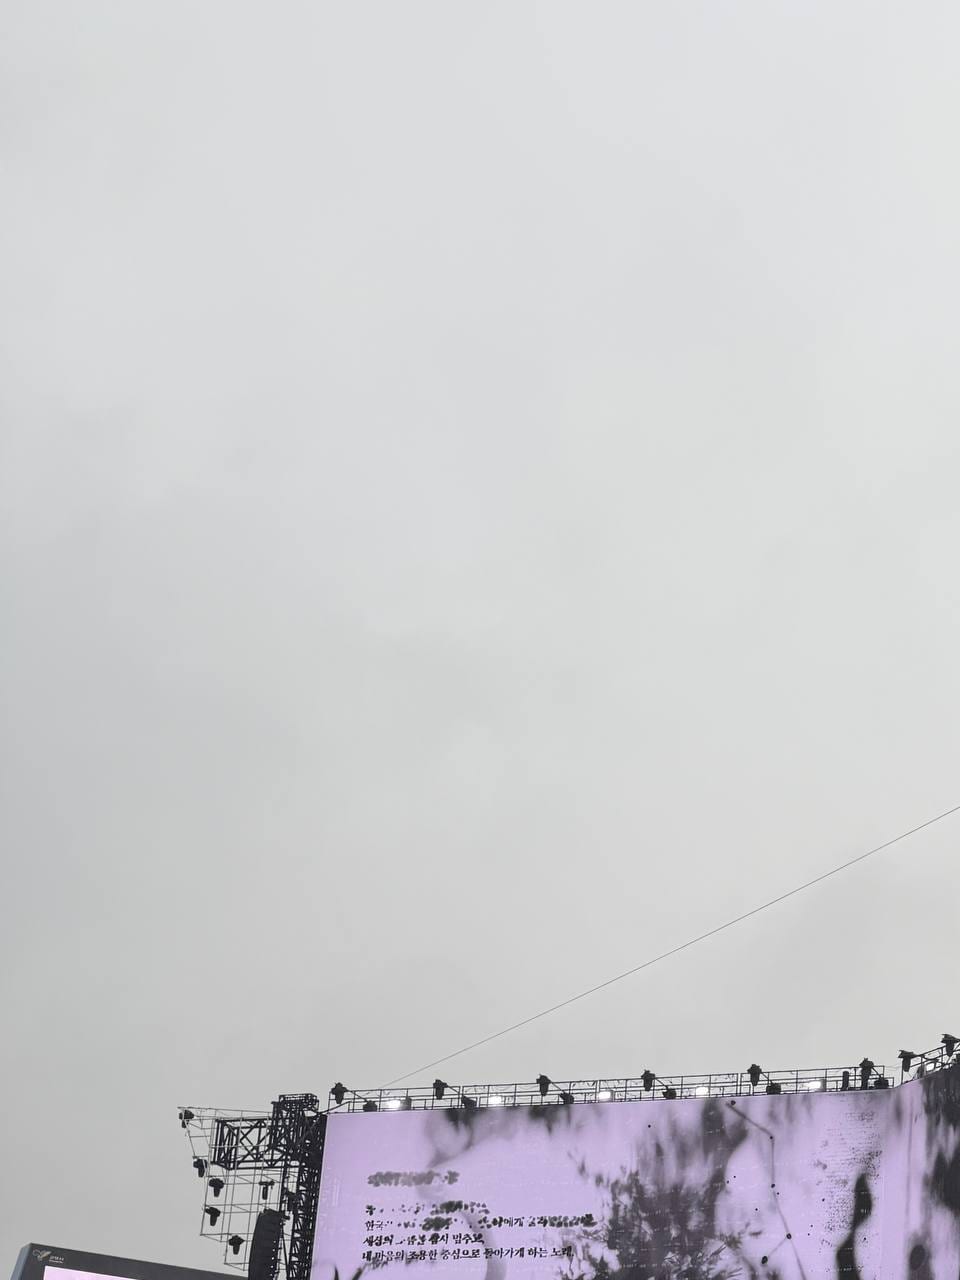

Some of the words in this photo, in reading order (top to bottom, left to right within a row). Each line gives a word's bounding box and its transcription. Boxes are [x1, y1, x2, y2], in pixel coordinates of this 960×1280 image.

[362, 1250, 372, 1261] 내
[375, 1249, 405, 1261] 마음의
[408, 1248, 437, 1261] 조용한
[440, 1248, 481, 1260] 중심으로
[483, 1247, 525, 1259] 돌아가게
[527, 1246, 549, 1258] 하는
